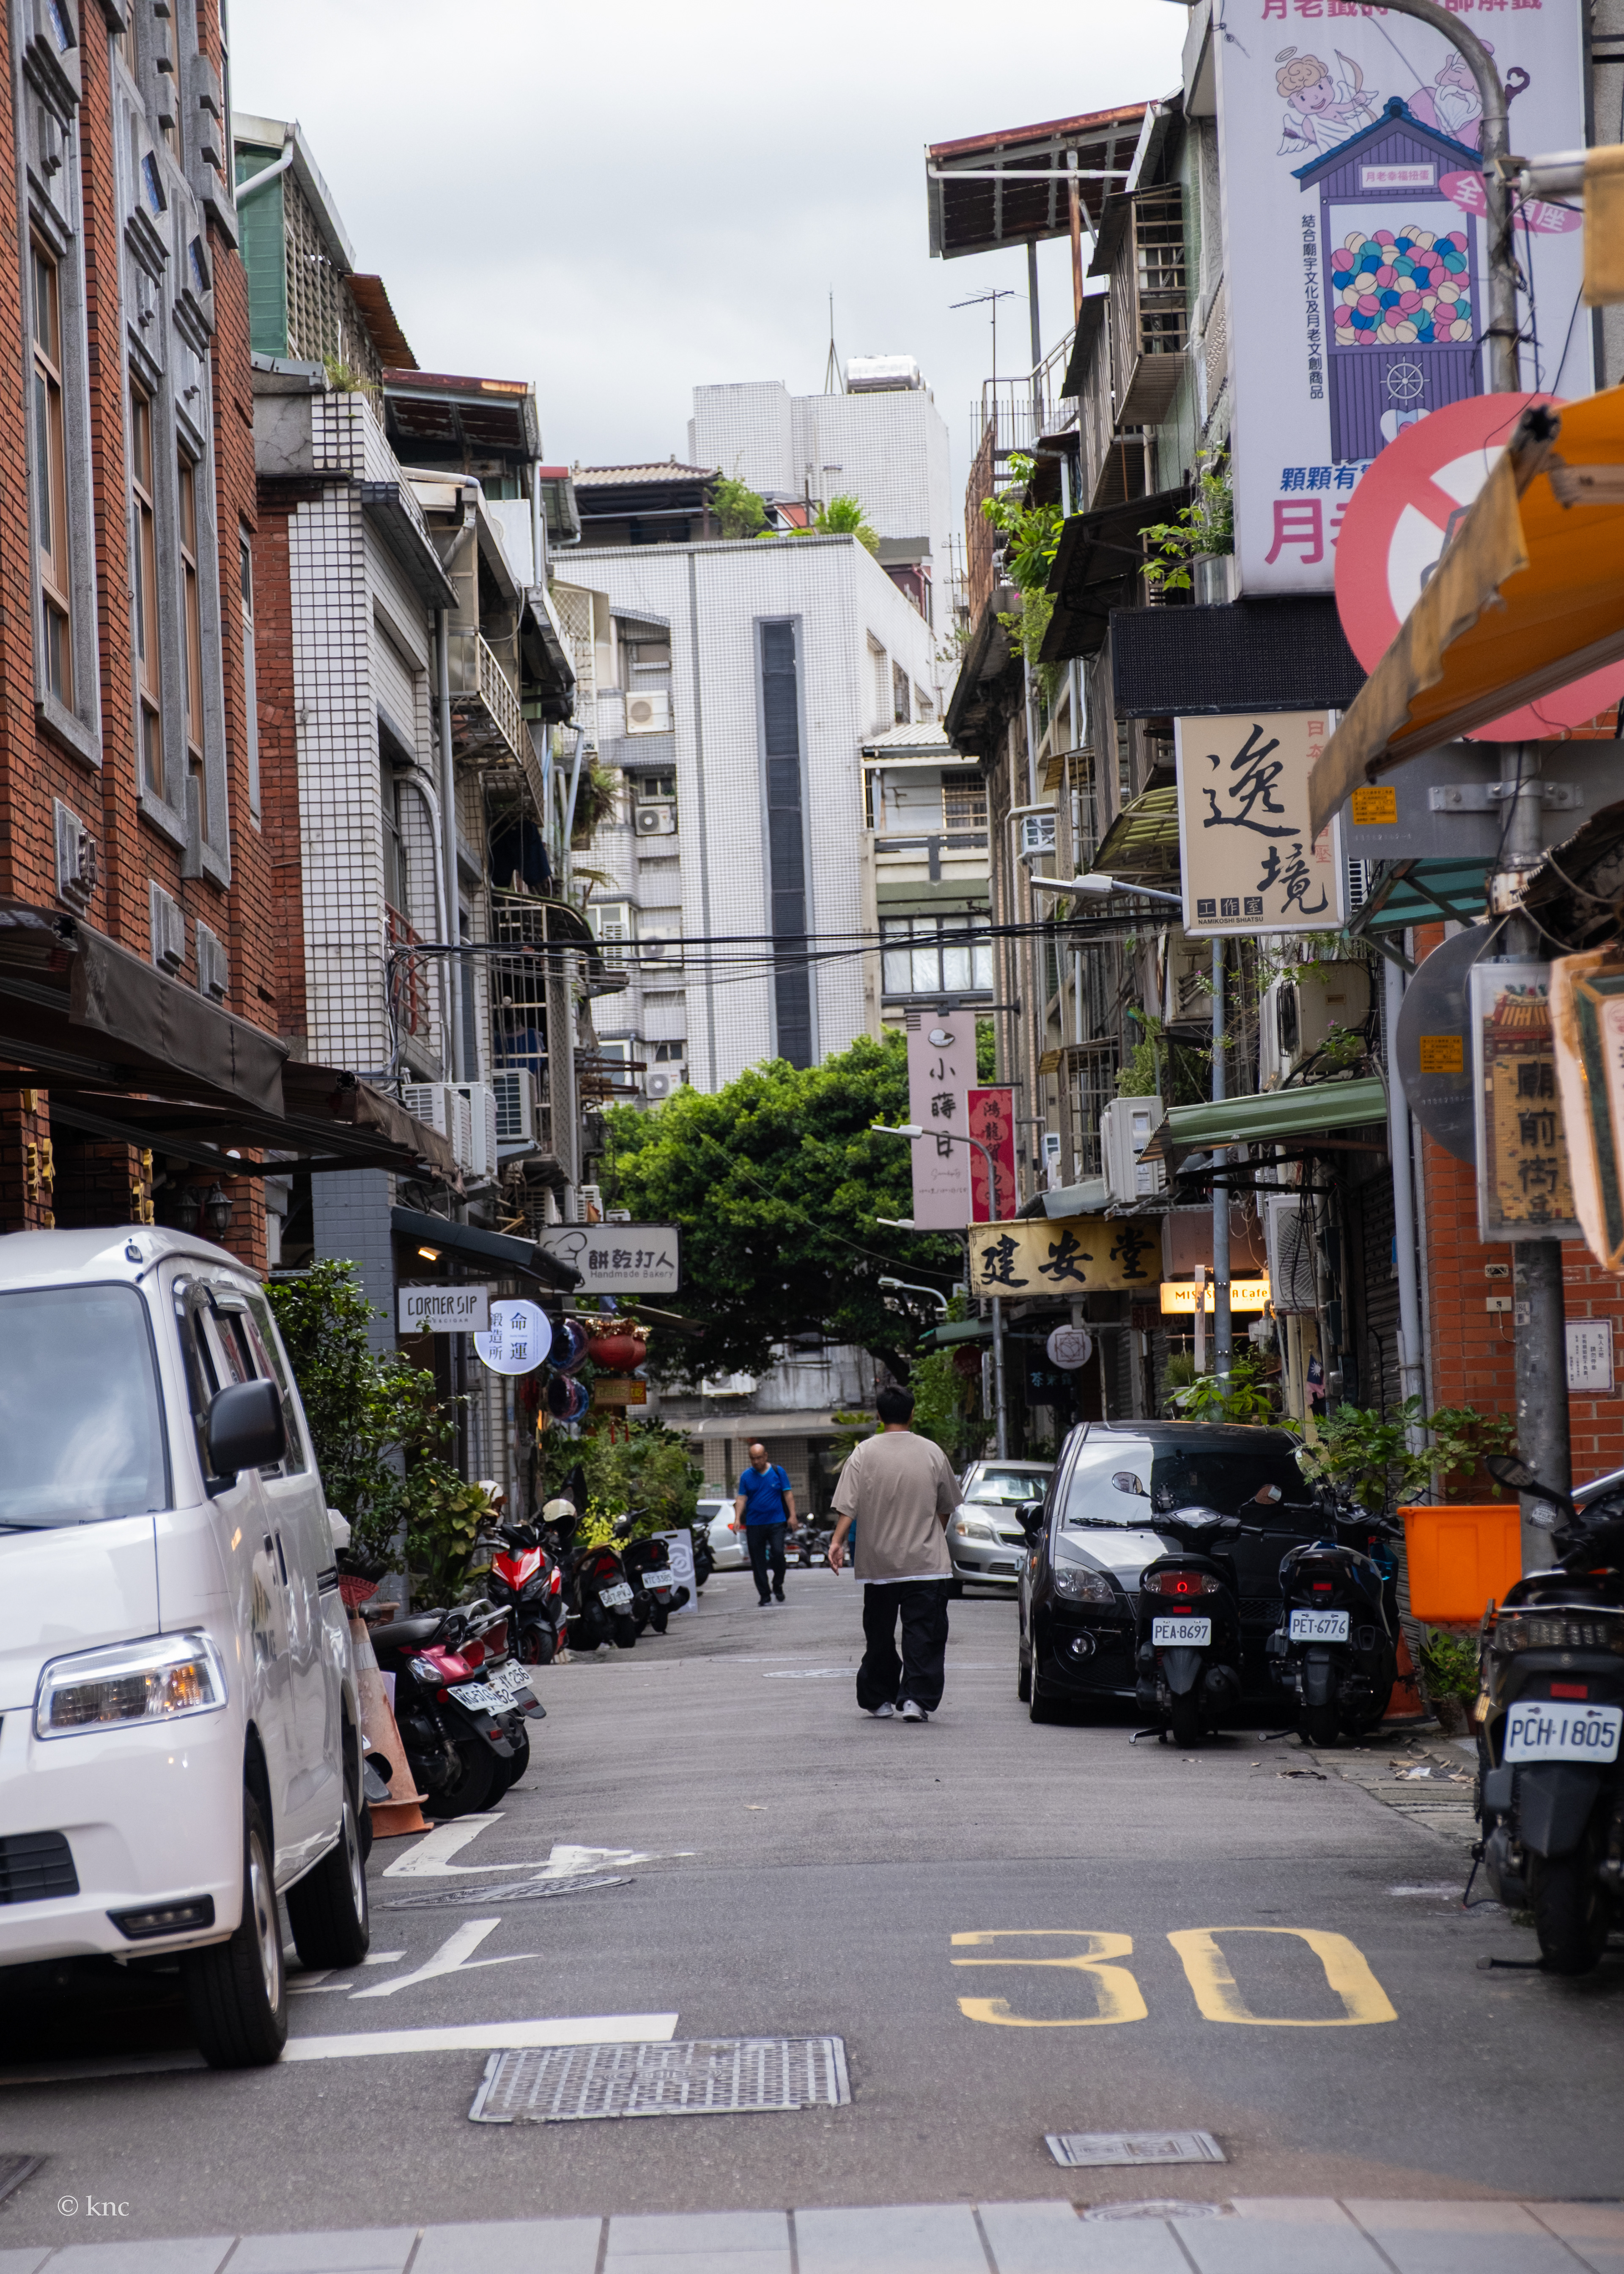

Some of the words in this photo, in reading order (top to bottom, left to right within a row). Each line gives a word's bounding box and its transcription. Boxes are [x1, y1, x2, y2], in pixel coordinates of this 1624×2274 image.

[1366, 170, 1429, 182] 月老幸福扭蛋
[1453, 175, 1566, 232] 全首座
[1302, 214, 1324, 399] 結合廟宇文化及月老文創商品
[1197, 896, 1263, 917] 工作室
[589, 1249, 675, 1270] 餅乾打人
[980, 1227, 1155, 1288] 建安堂
[590, 1270, 639, 1278] Handmade
[642, 1270, 674, 1279] Bakery
[510, 1312, 528, 1360] 命運
[1155, 1625, 1209, 1639] PEA-8697
[1292, 1618, 1346, 1634] PET-6776
[1510, 1718, 1617, 1748] PCH-1805
[949, 1926, 1399, 2027] 30
